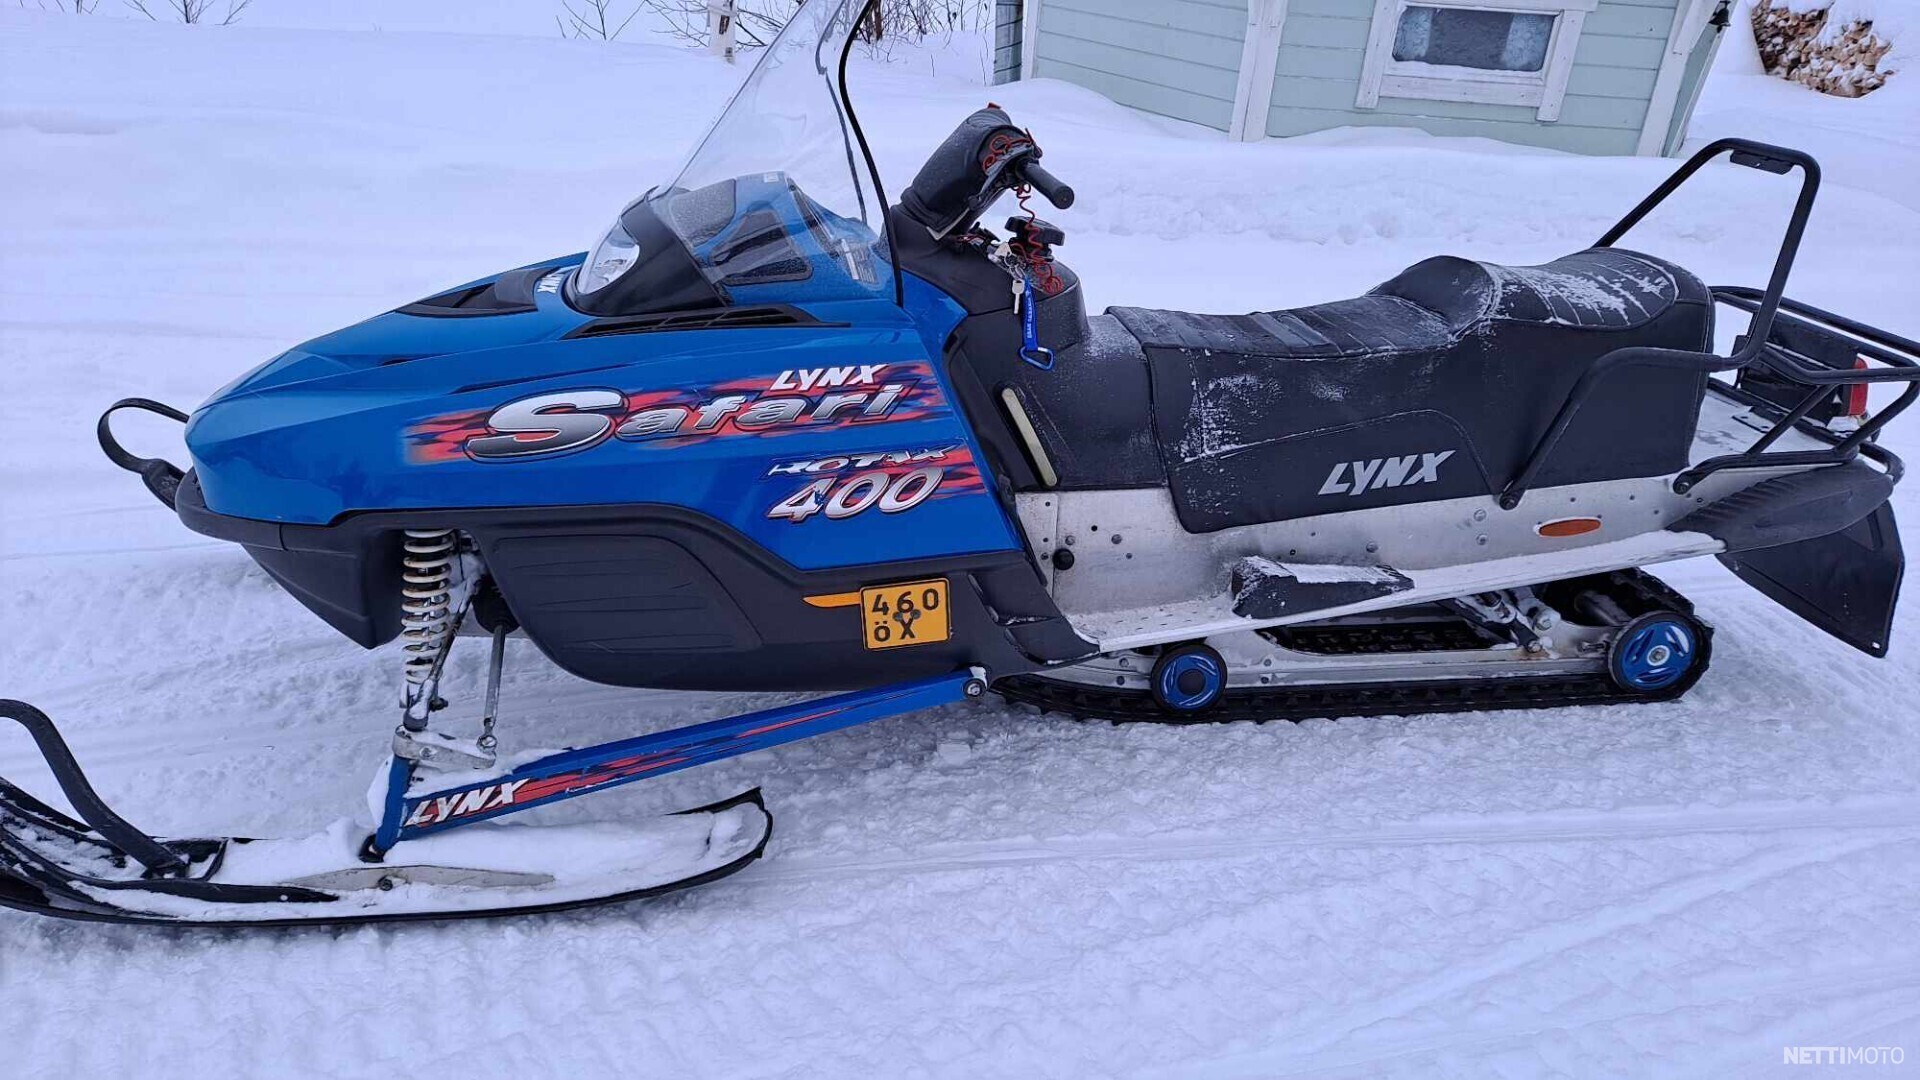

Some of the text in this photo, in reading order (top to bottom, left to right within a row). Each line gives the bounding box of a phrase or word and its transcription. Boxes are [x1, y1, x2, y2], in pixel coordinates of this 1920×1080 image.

[770, 363, 888, 392] LYNX
[466, 384, 905, 459] Safari
[767, 466, 944, 523] 400
[1317, 450, 1456, 496] LYNX
[872, 588, 939, 615] 460
[404, 778, 530, 827] LYNX
